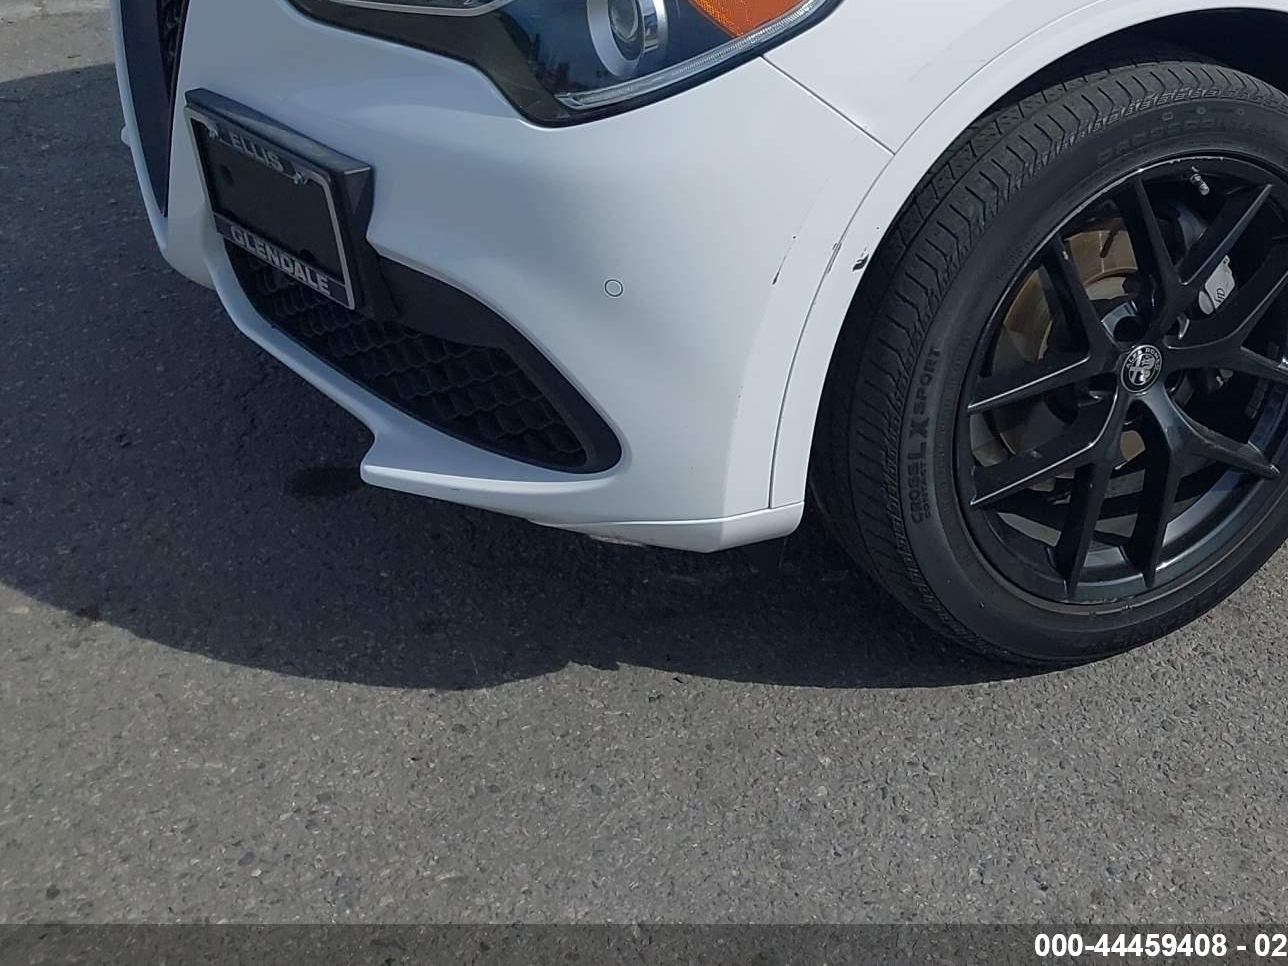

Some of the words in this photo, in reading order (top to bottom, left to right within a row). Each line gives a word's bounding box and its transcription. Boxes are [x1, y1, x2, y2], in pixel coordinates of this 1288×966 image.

[229, 131, 284, 172] ELLIS
[230, 225, 331, 296] GLENDALE
[913, 346, 941, 415] SPORT
[1126, 350, 1142, 369] ALFA
[1145, 347, 1161, 371] ROMEO
